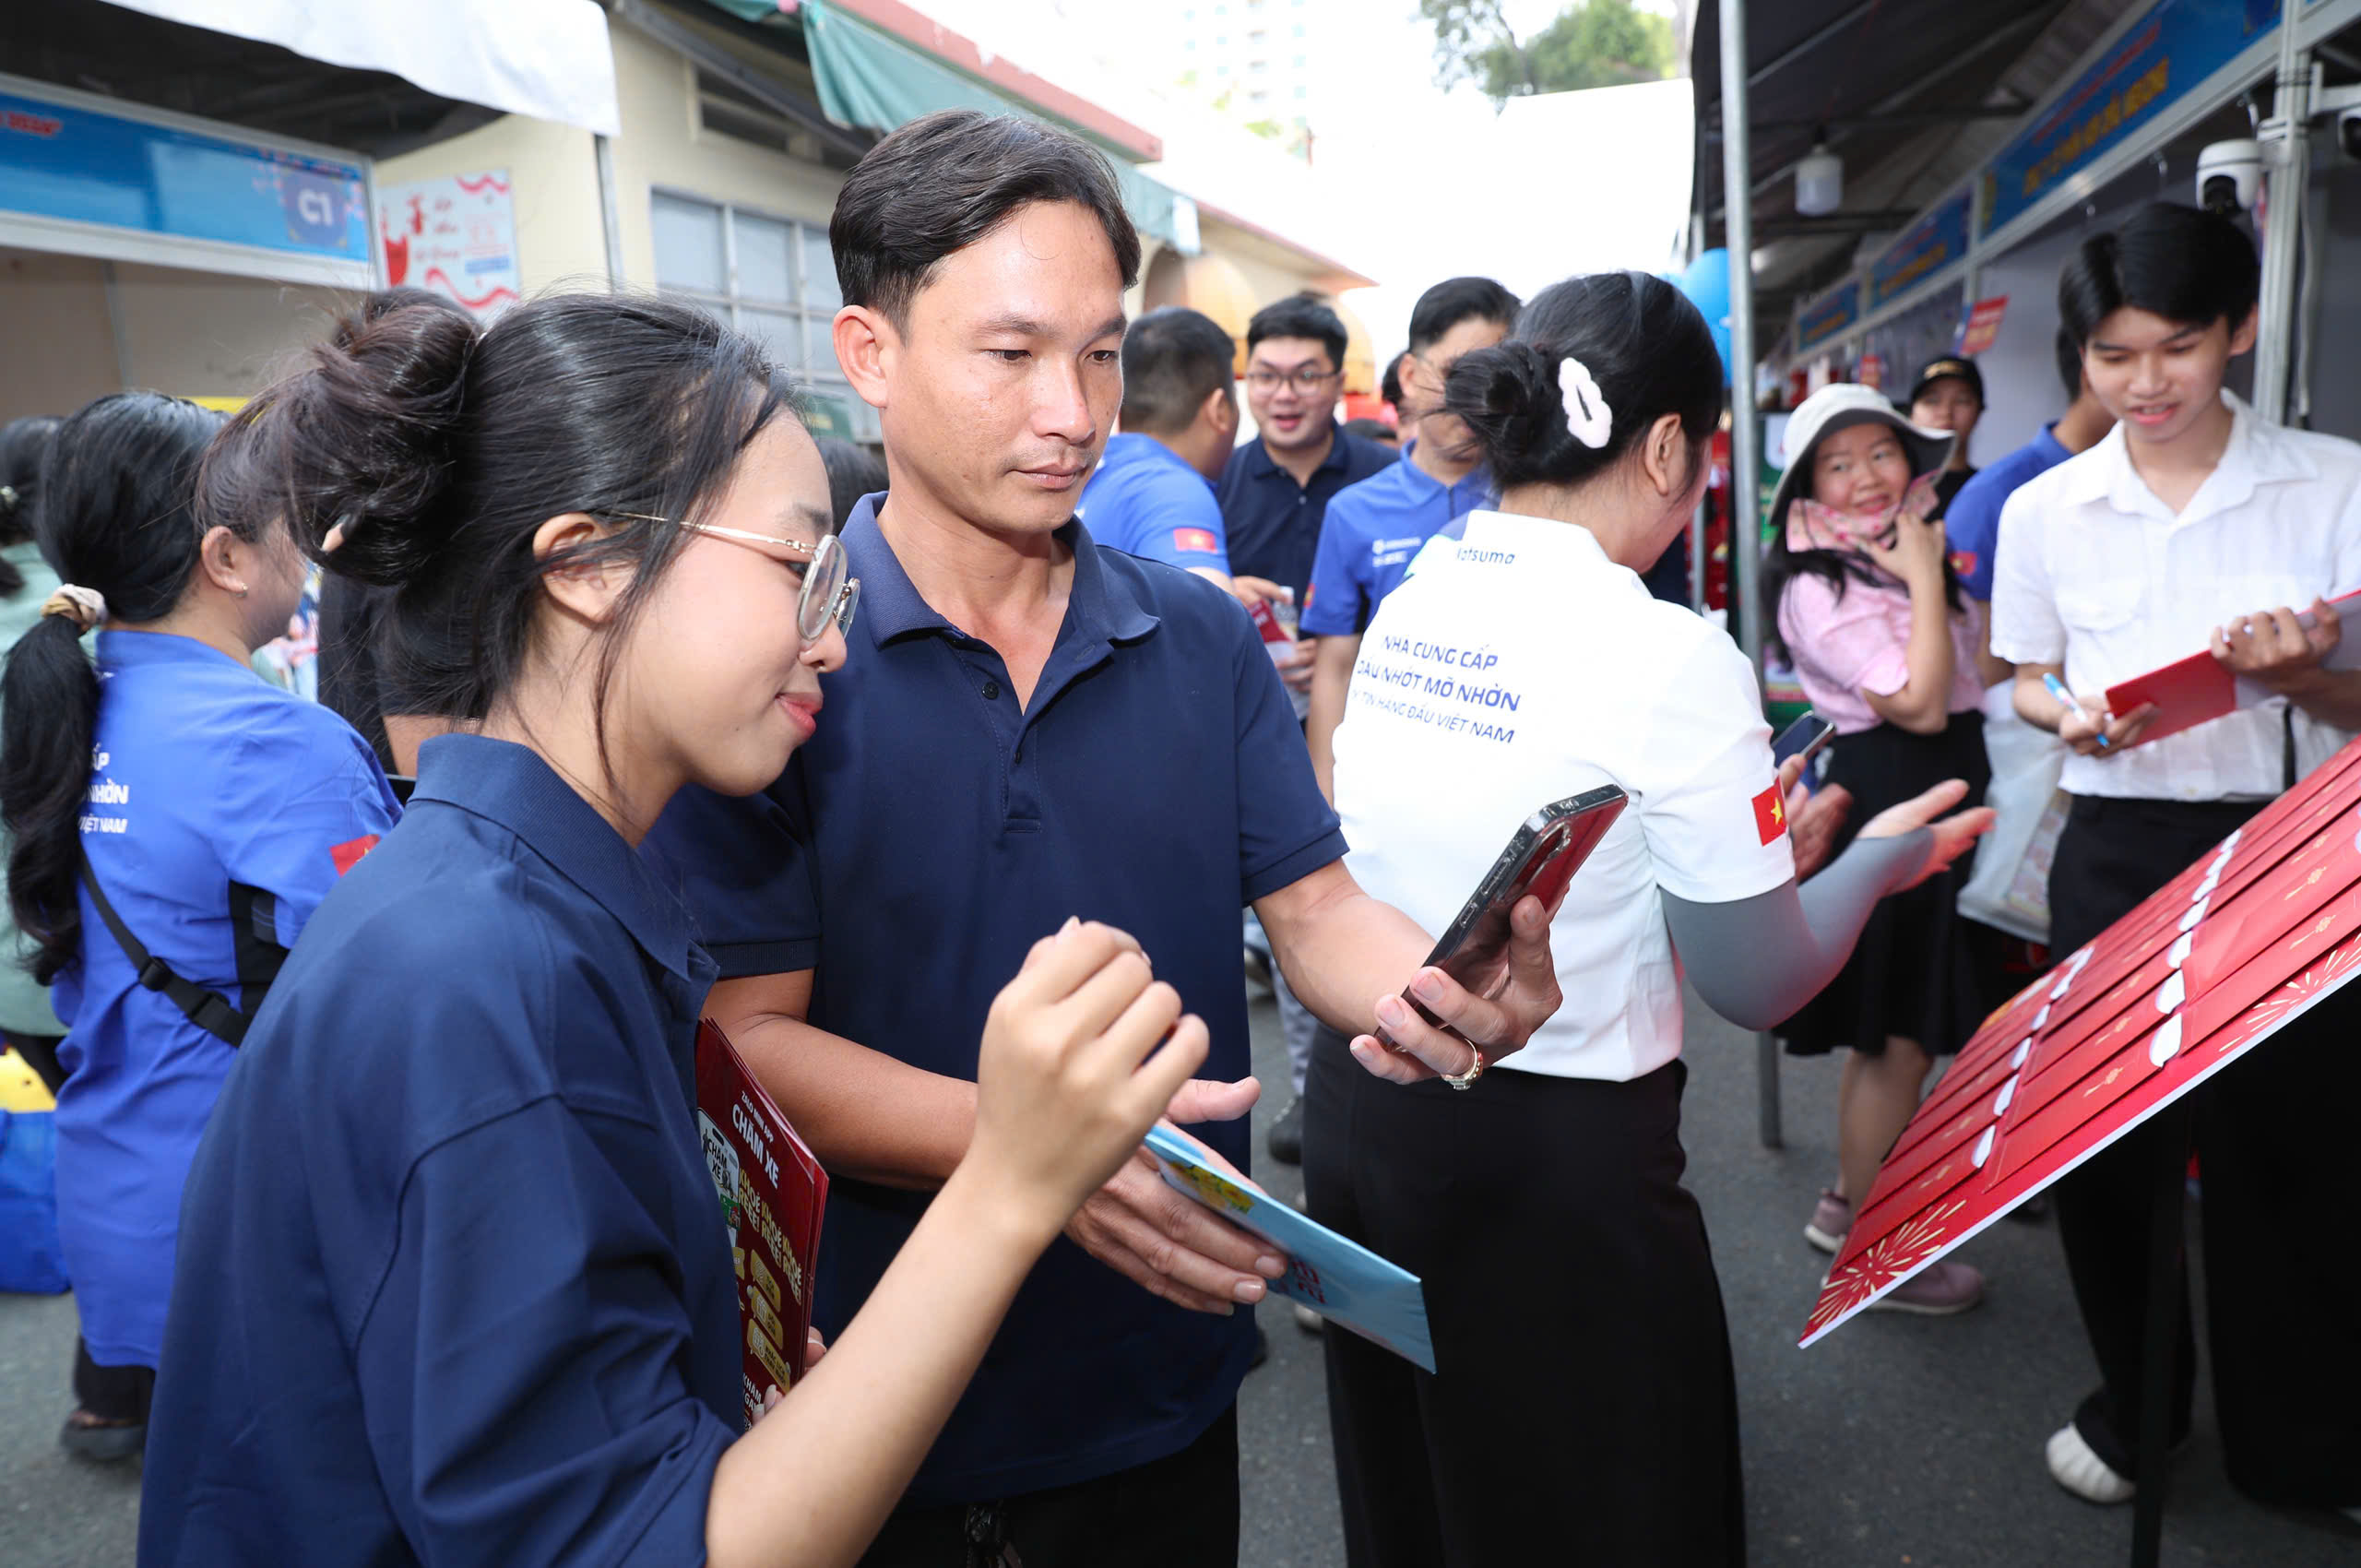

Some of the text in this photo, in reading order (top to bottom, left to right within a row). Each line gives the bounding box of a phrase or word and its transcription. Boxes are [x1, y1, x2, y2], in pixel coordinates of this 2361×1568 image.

[1413, 641, 1457, 665] CUNG
[1460, 644, 1499, 671] CẤP
[1455, 683, 1521, 712] NHỜN
[1469, 720, 1515, 744] NAM
[711, 1158, 721, 1181] XE
[765, 1148, 779, 1190] XE
